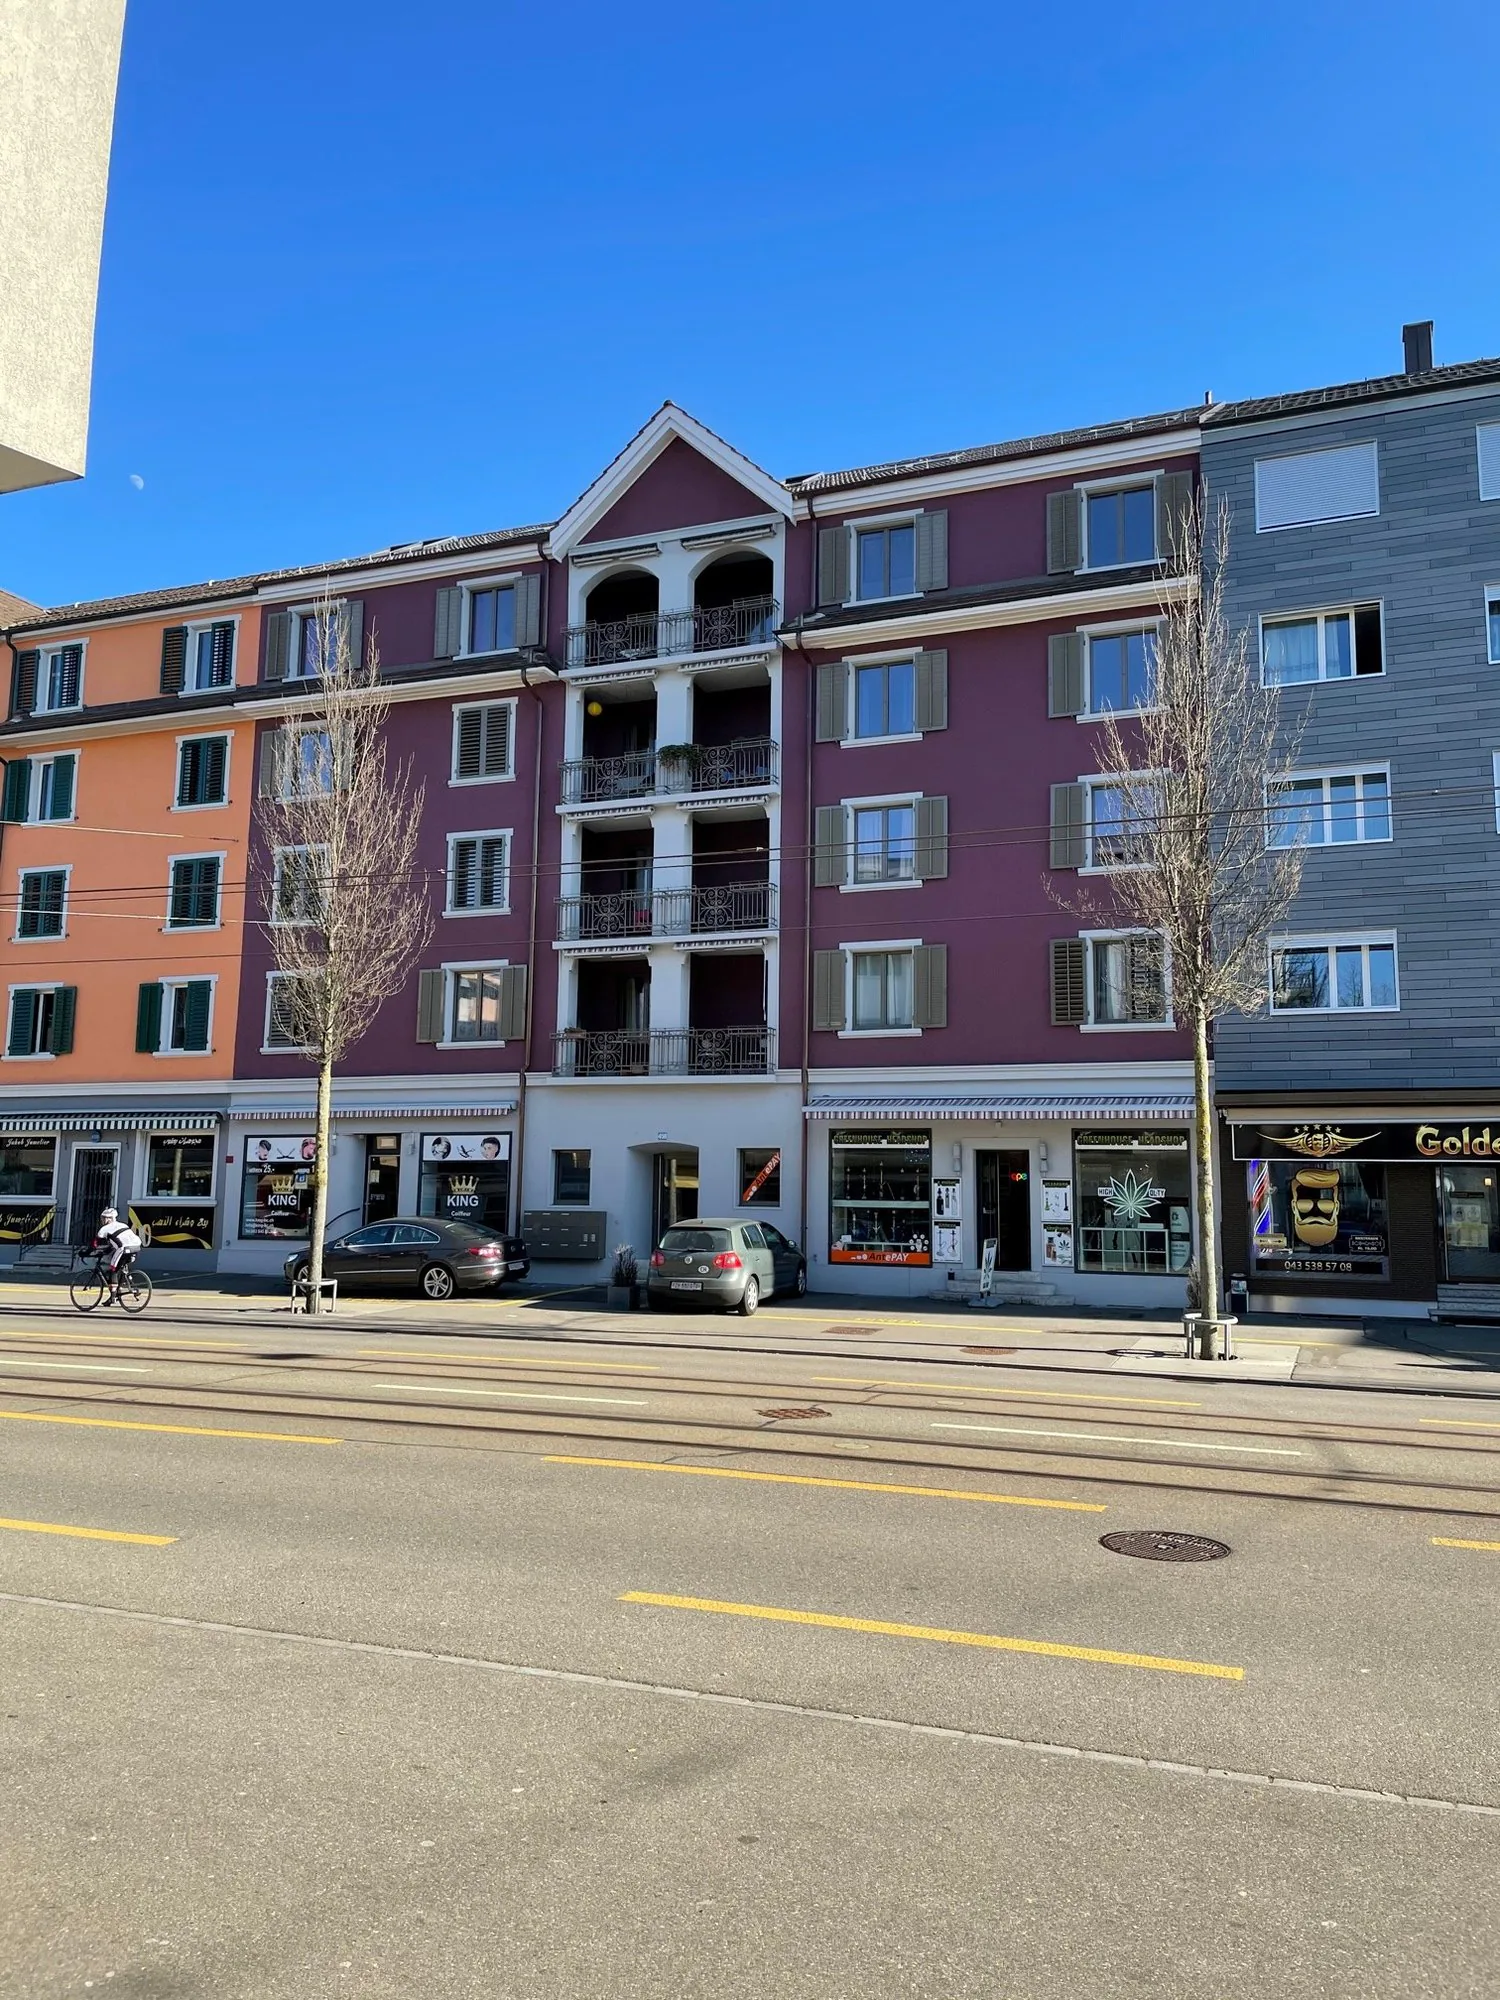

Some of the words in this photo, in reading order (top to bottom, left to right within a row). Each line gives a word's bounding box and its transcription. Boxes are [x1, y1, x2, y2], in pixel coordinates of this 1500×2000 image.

[833, 1134, 882, 1144] GREENHOUSE
[886, 1134, 928, 1144] HEADSHOP
[1077, 1135, 1133, 1145] GREENHOUSE
[1137, 1135, 1186, 1146] HEADSHOP
[1098, 1187, 1113, 1196] HIGH
[267, 1195, 297, 1206] KING
[447, 1195, 479, 1207] KING
[868, 1252, 909, 1262] AntePAY
[1284, 1261, 1302, 1270] 043
[1304, 1261, 1323, 1271] 538
[1325, 1262, 1337, 1271] 57
[1339, 1262, 1352, 1271] 08
